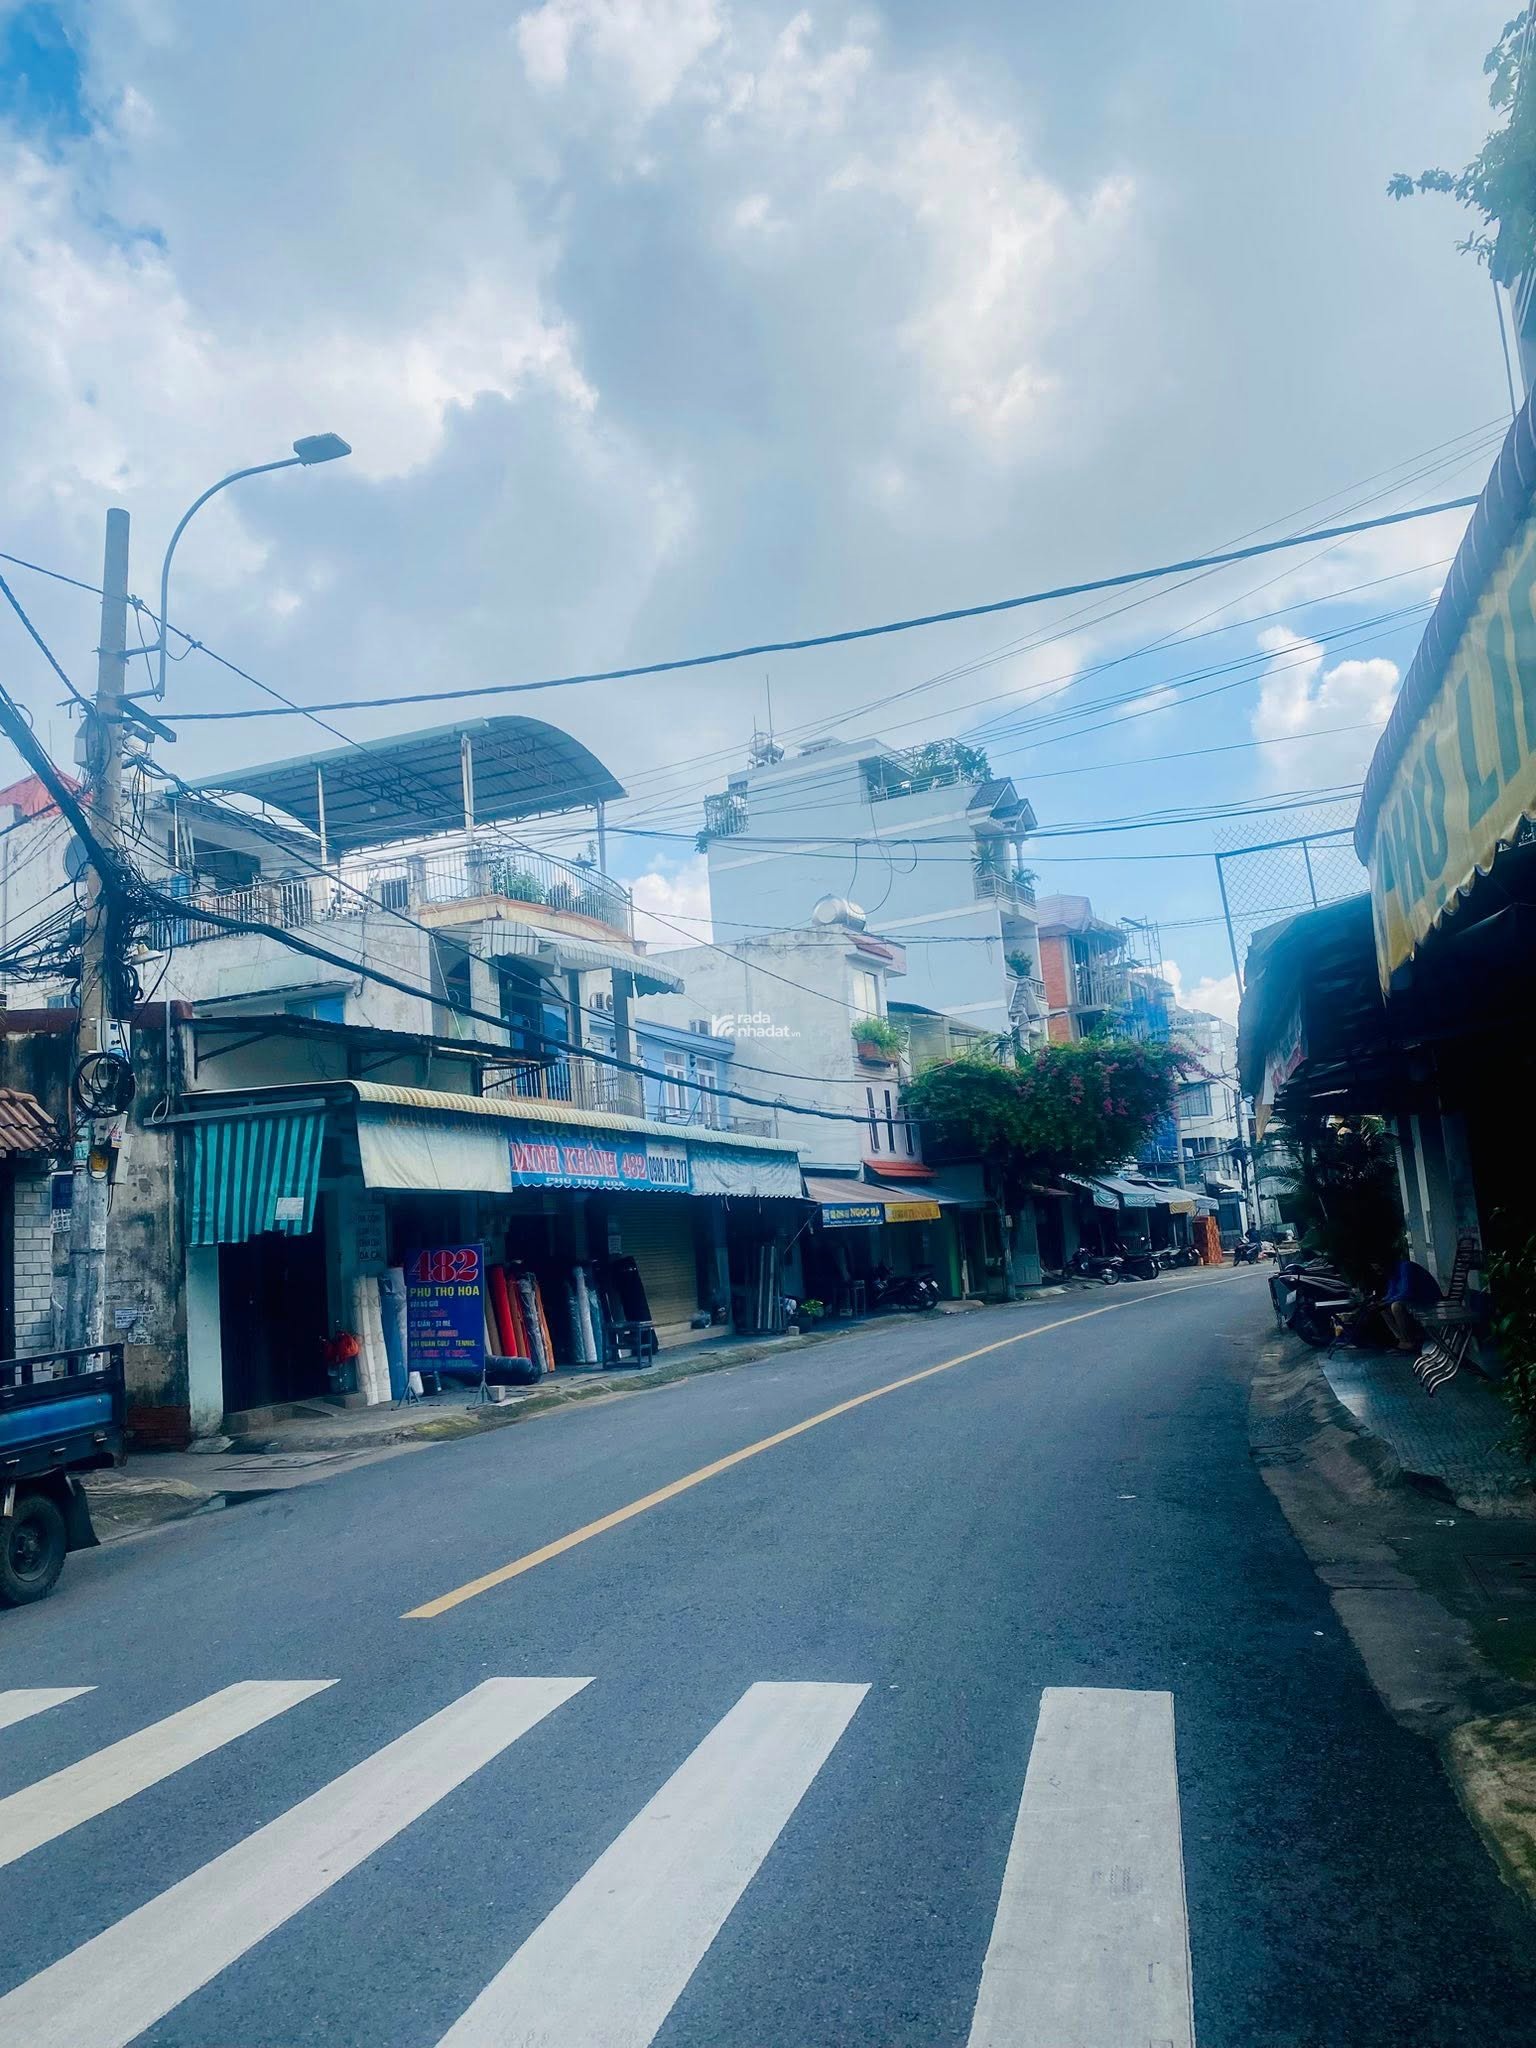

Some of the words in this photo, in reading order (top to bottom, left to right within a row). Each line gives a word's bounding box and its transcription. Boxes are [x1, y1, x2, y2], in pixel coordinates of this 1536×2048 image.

[510, 1143, 561, 1174] MINH
[563, 1143, 620, 1177] KHÁNH
[622, 1153, 648, 1178] 482
[408, 1248, 479, 1283] 482
[434, 1286, 454, 1298] THỌ
